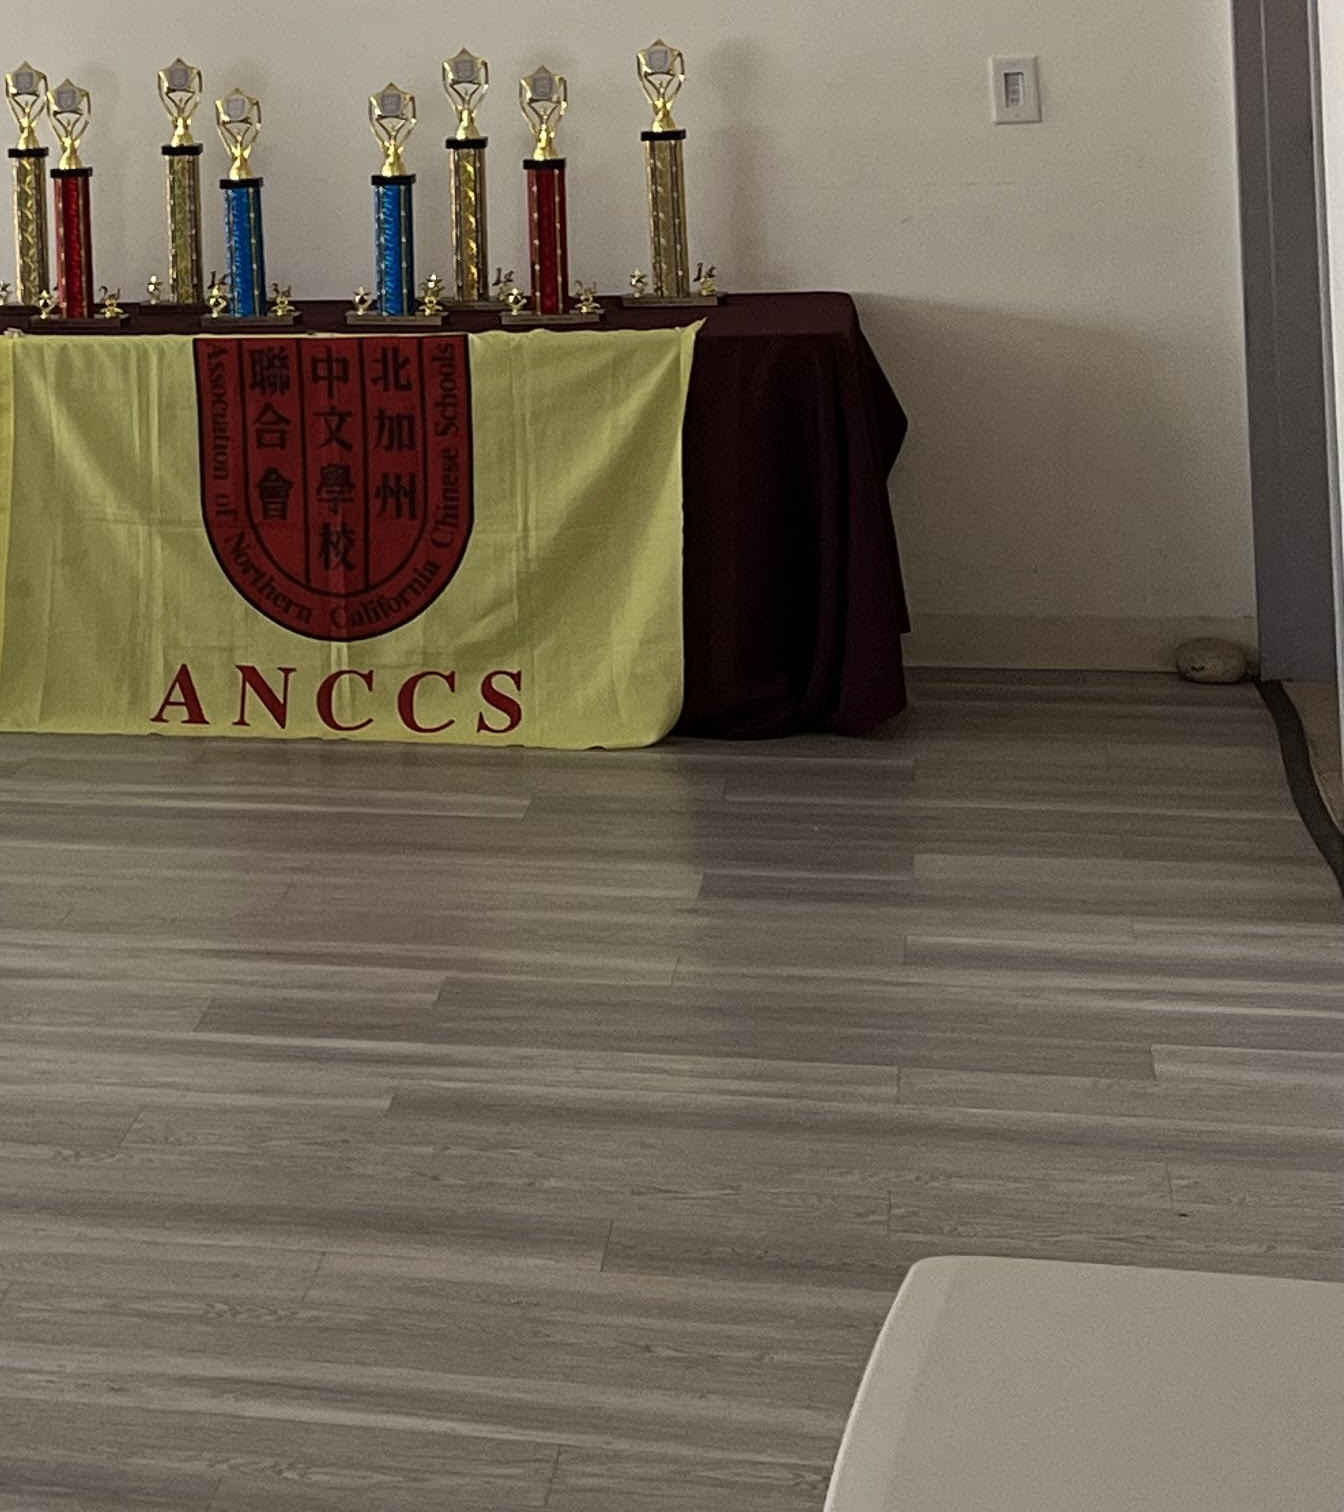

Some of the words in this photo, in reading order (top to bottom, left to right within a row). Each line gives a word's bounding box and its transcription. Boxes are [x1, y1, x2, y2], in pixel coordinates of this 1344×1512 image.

[207, 342, 231, 481] Association
[247, 345, 294, 521] 聯合會
[370, 345, 418, 521] 北加州
[431, 342, 460, 439] Schools
[309, 345, 357, 572] 中文學校
[430, 447, 461, 550] Chinese
[223, 529, 312, 625] Northern
[329, 561, 442, 630] California
[150, 663, 524, 735] ANCCS
